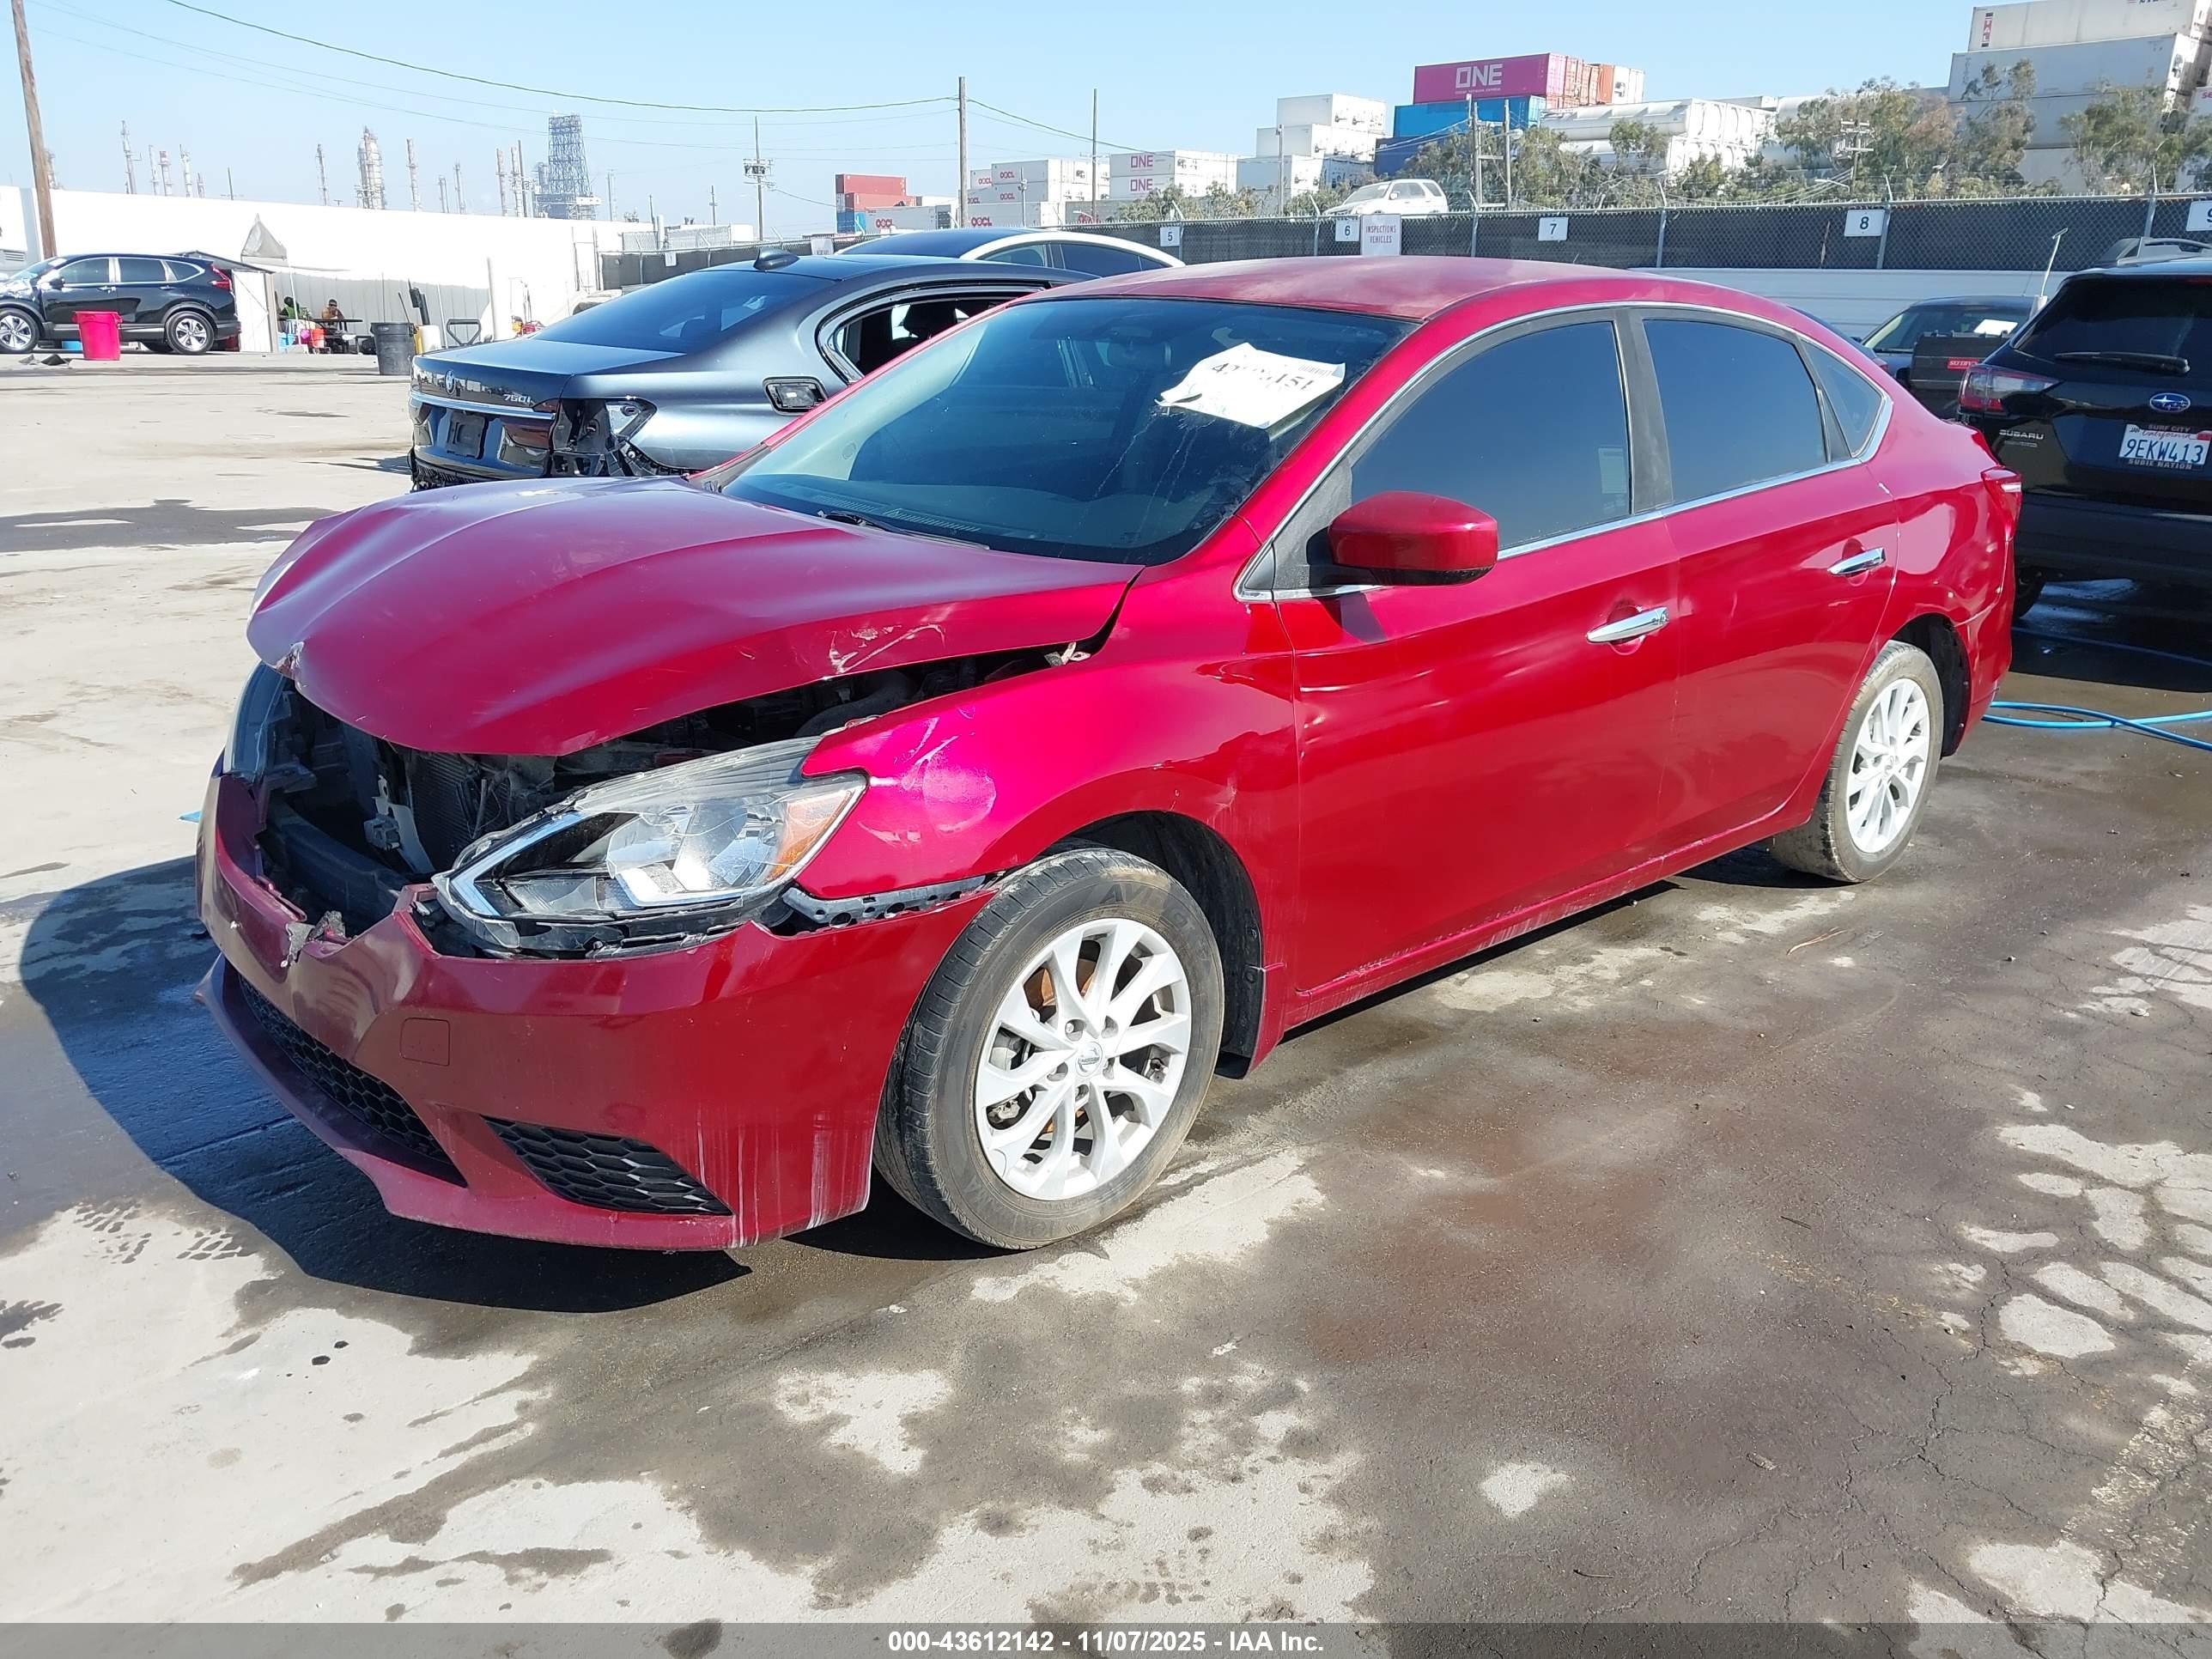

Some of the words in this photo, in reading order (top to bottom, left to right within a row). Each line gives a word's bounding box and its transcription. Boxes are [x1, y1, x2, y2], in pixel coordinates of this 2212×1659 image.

[1456, 64, 1503, 88] ONE
[1130, 155, 1153, 168] ONE
[1130, 178, 1153, 192] ONE
[970, 216, 993, 227] OOCL
[1860, 216, 1869, 229] 8
[1344, 225, 1351, 236] 6
[1550, 223, 1557, 235] 7
[1167, 232, 1173, 241] 5
[1999, 429, 2045, 440] SUBARU
[2124, 439, 2204, 463] 9EKW413
[2157, 460, 2192, 471] NATION
